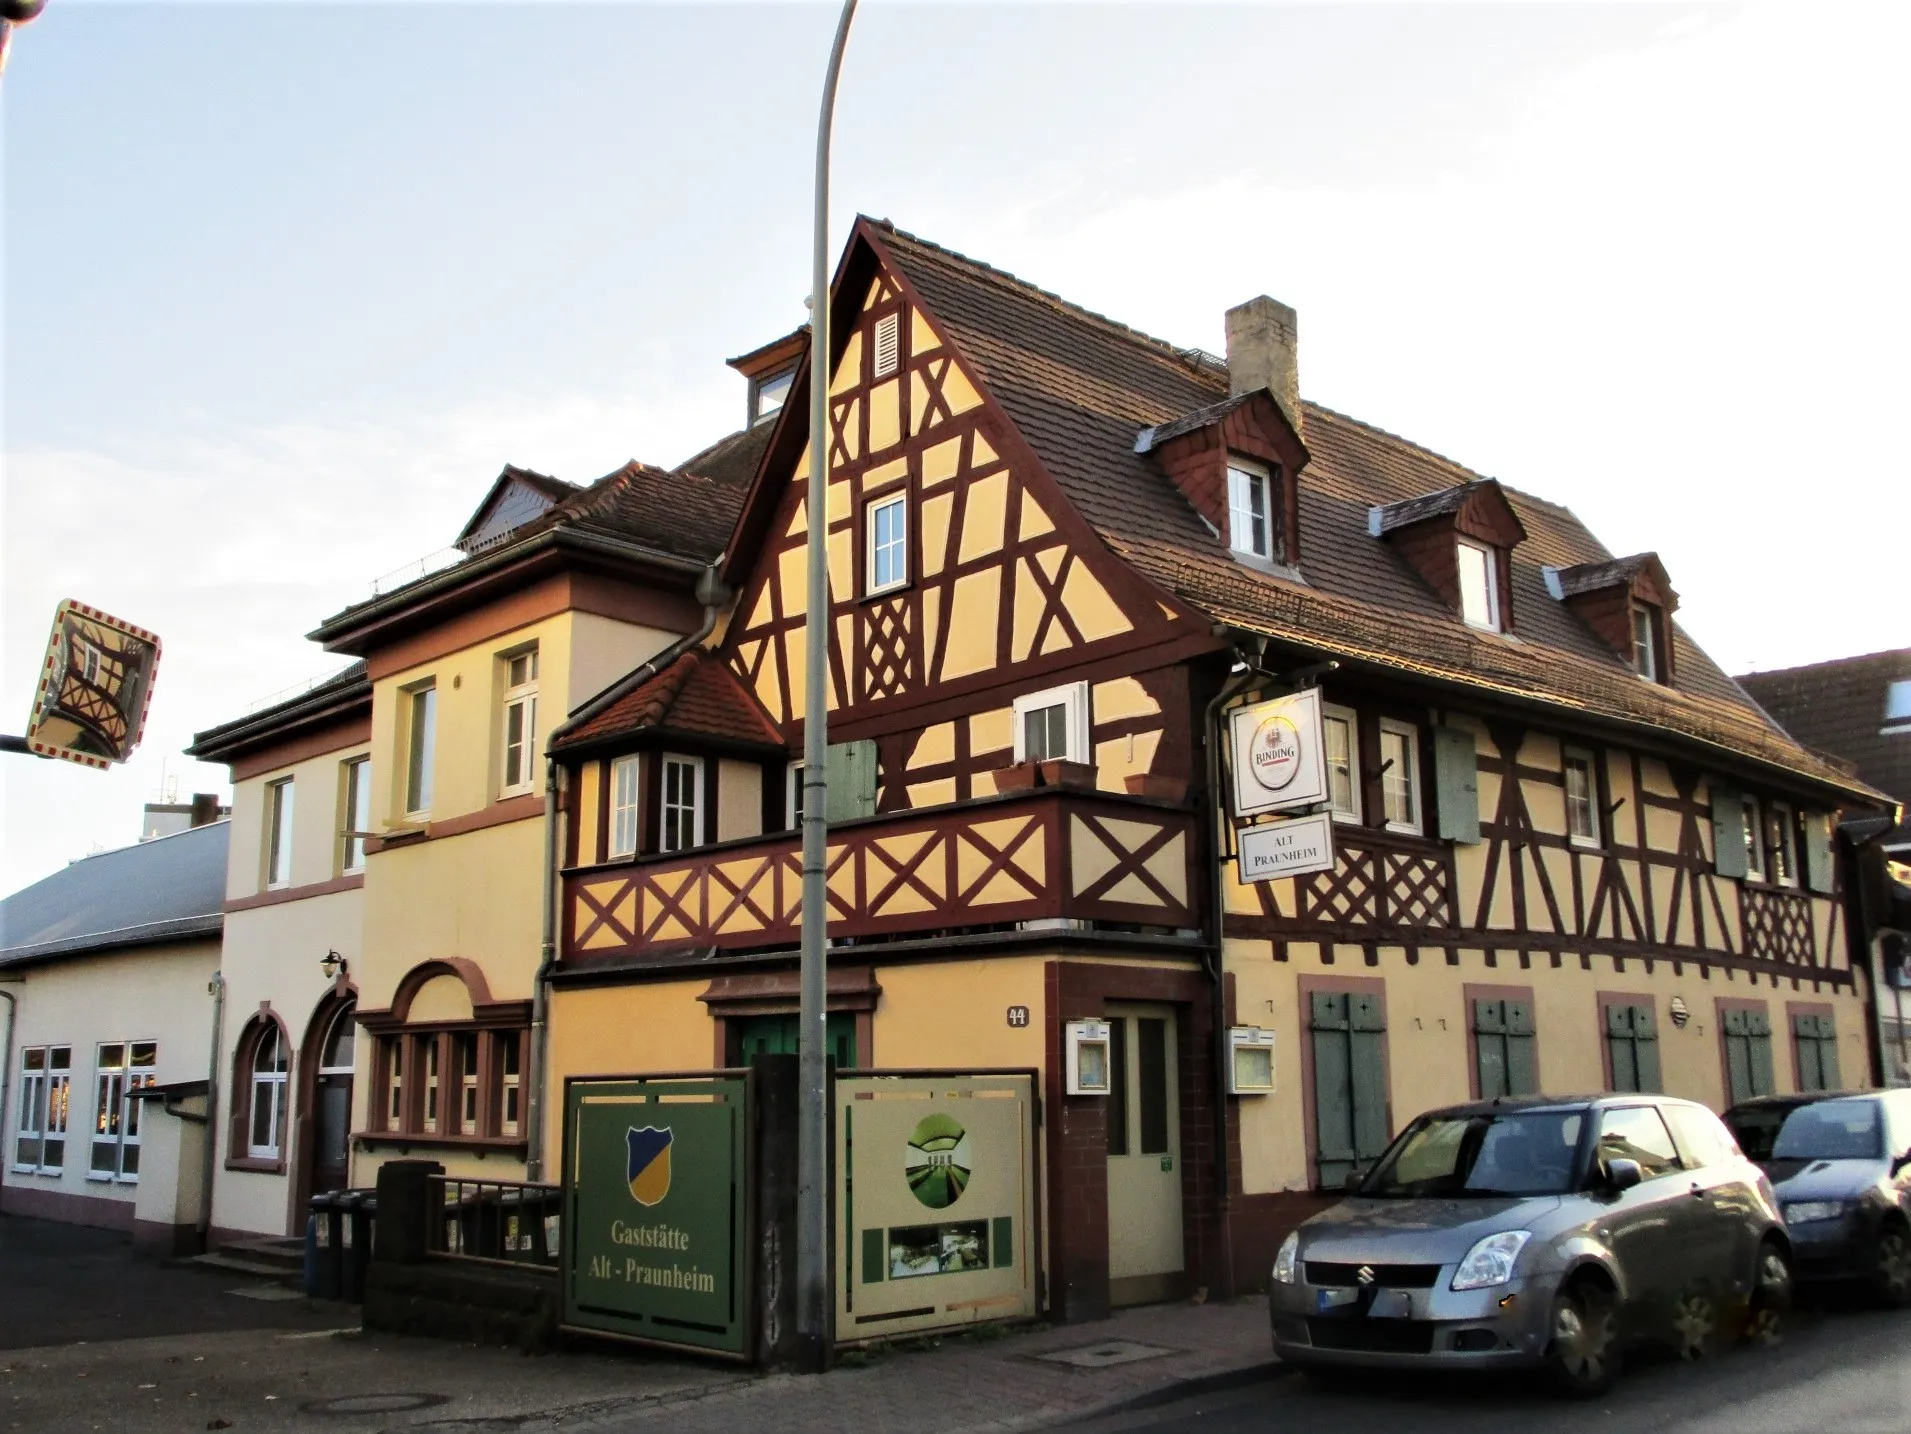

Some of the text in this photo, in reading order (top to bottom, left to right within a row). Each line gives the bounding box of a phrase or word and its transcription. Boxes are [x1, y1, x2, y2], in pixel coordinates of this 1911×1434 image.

[1256, 745, 1295, 765] BINDING
[1274, 835, 1293, 847] ALT
[1254, 847, 1317, 867] PRAUNHEIM
[1010, 1008, 1025, 1025] 44
[611, 1219, 690, 1251] Gaststätte
[588, 1255, 612, 1279] Alt
[625, 1257, 715, 1293] Praunheim
